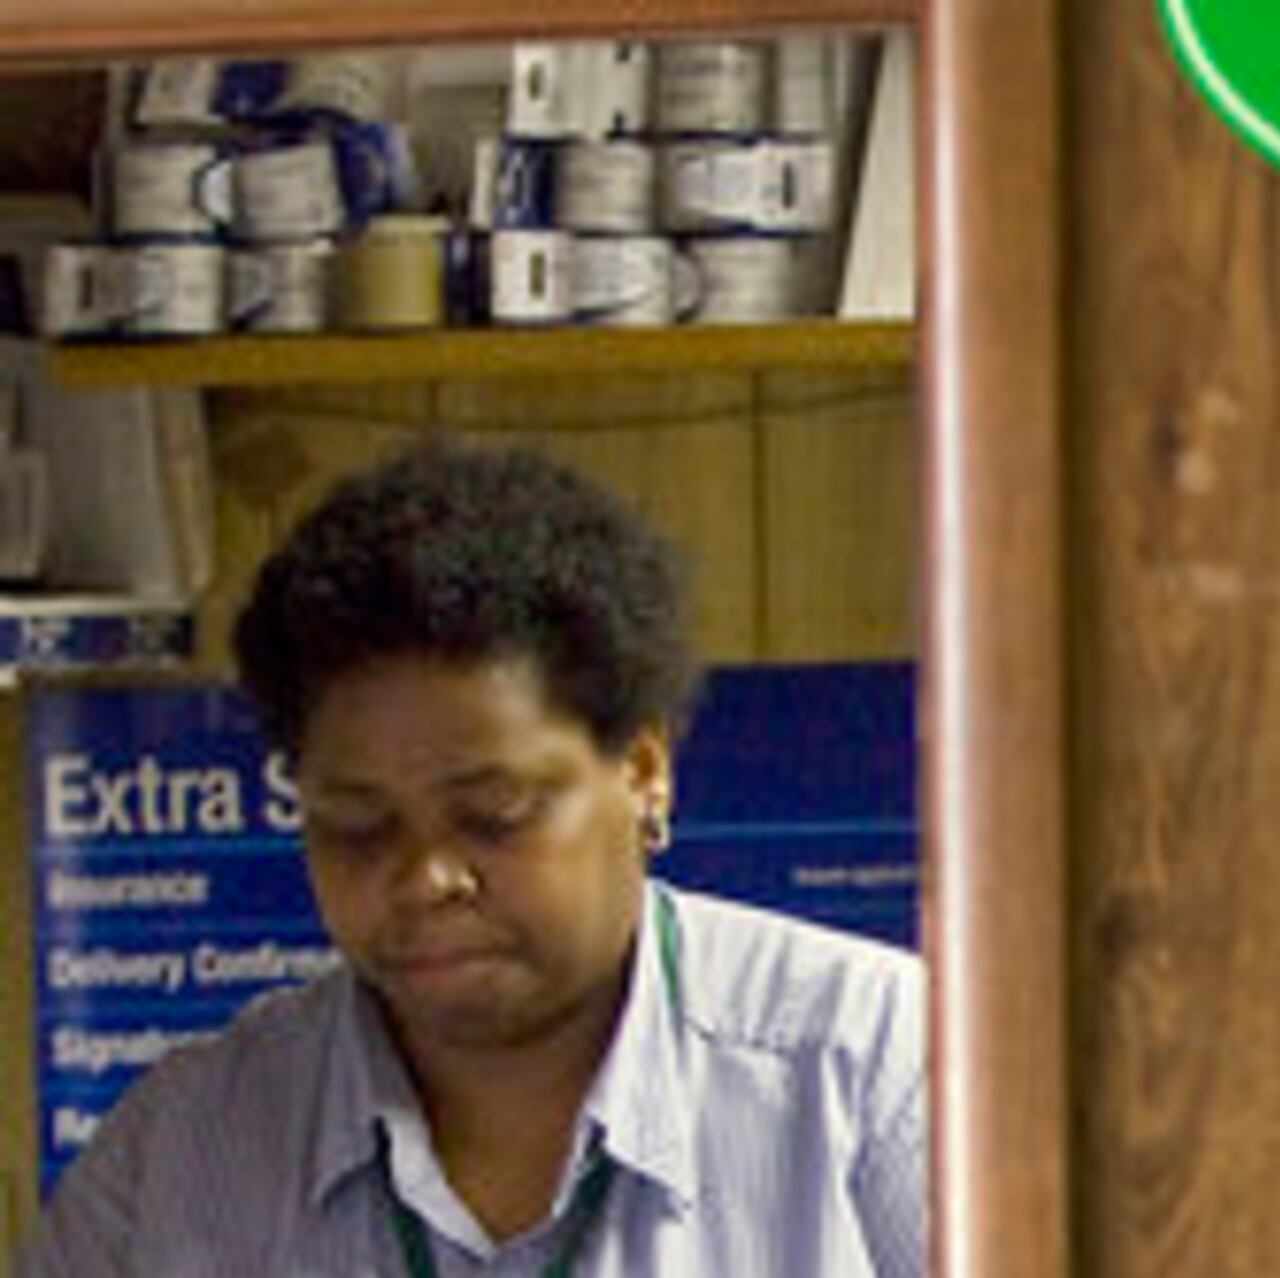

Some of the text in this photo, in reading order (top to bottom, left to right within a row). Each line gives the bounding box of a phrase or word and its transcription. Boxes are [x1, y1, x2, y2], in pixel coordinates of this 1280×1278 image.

[47, 753, 305, 833] Extra S
[50, 950, 185, 993] Delivery
